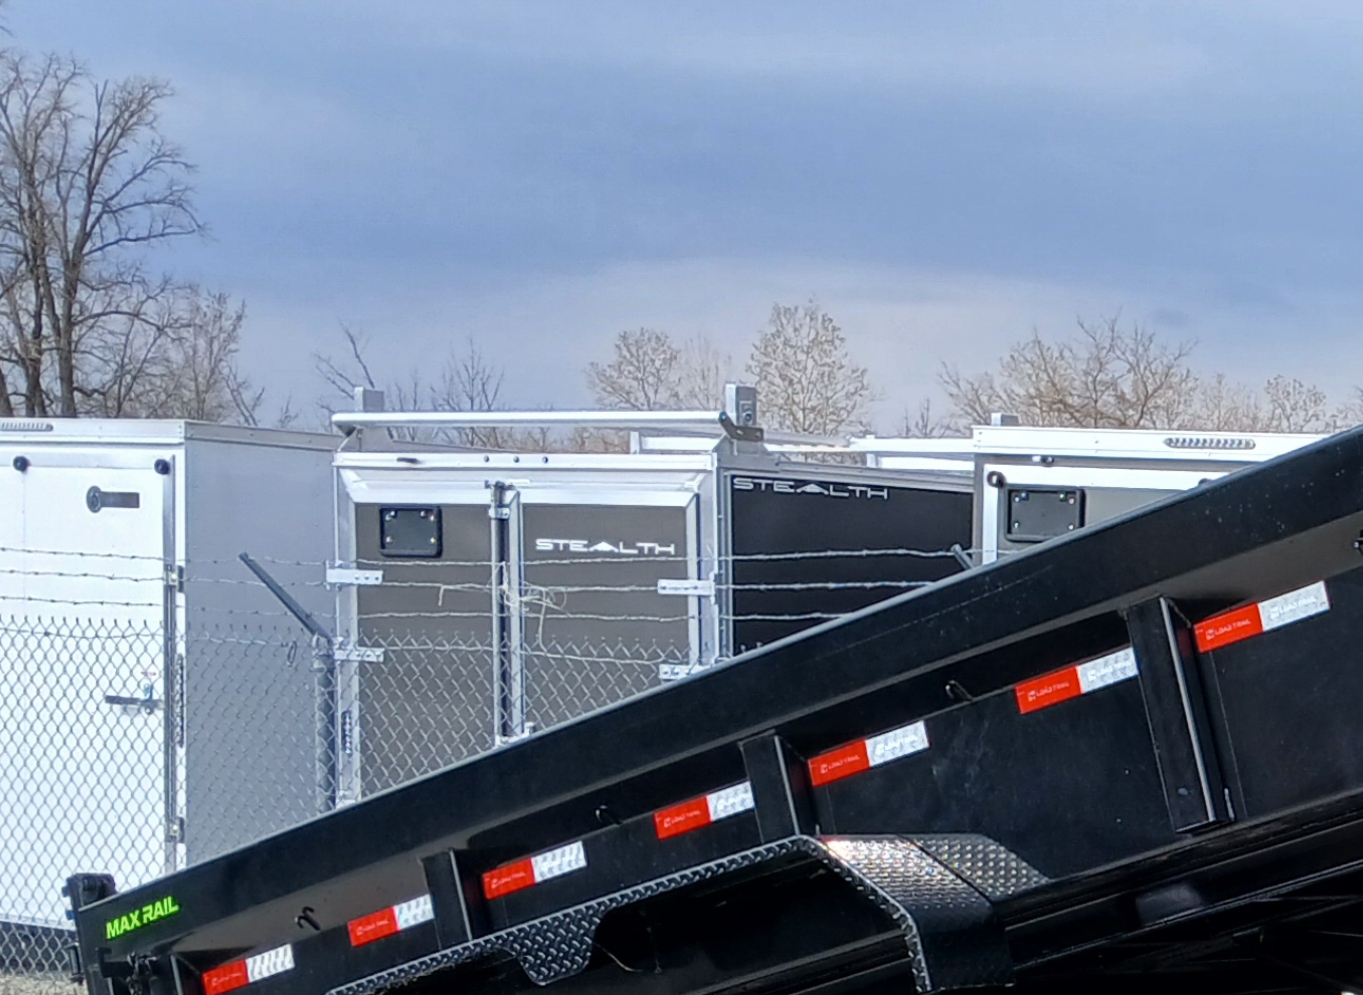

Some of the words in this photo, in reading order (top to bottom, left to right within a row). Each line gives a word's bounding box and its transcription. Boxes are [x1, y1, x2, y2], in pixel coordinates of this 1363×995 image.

[733, 477, 888, 499] STEALTH
[535, 538, 675, 555] STEALTH
[105, 909, 141, 939] MAX
[142, 896, 180, 924] RAIL
